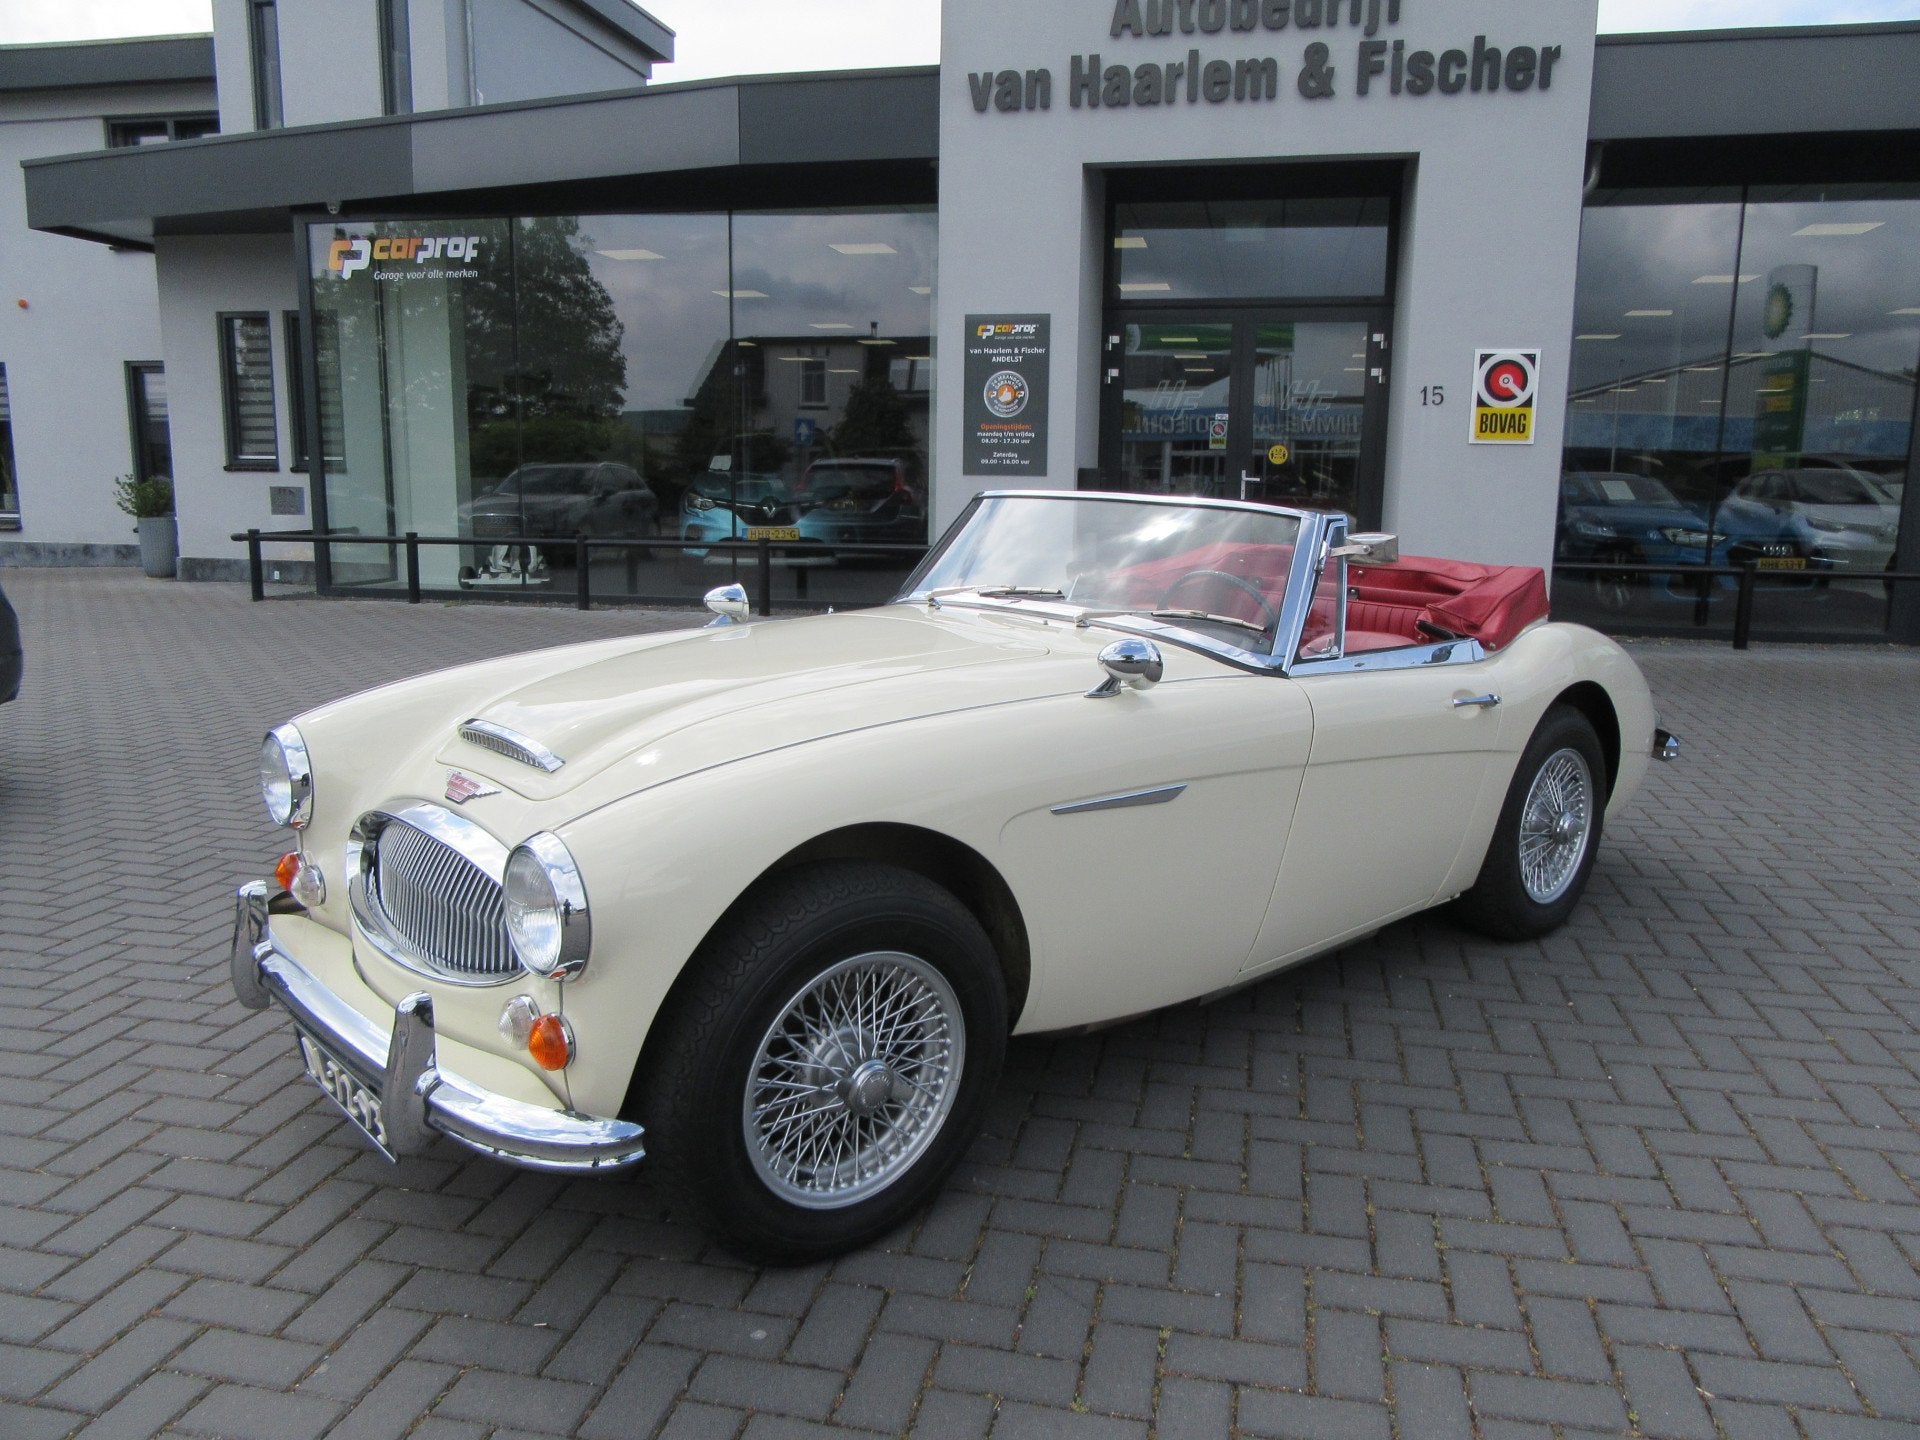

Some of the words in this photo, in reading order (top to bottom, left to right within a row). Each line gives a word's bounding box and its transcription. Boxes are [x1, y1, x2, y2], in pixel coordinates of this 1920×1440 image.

[967, 68, 1051, 112] van
[1069, 49, 1278, 108] Haarlem
[1297, 41, 1335, 98] &
[1355, 35, 1562, 96] Fischer
[373, 270, 404, 282] Garage
[406, 271, 425, 280] voor
[428, 269, 444, 279] alle
[445, 268, 478, 279] merken
[1420, 385, 1445, 406] 15
[1479, 412, 1527, 434] BOVAG
